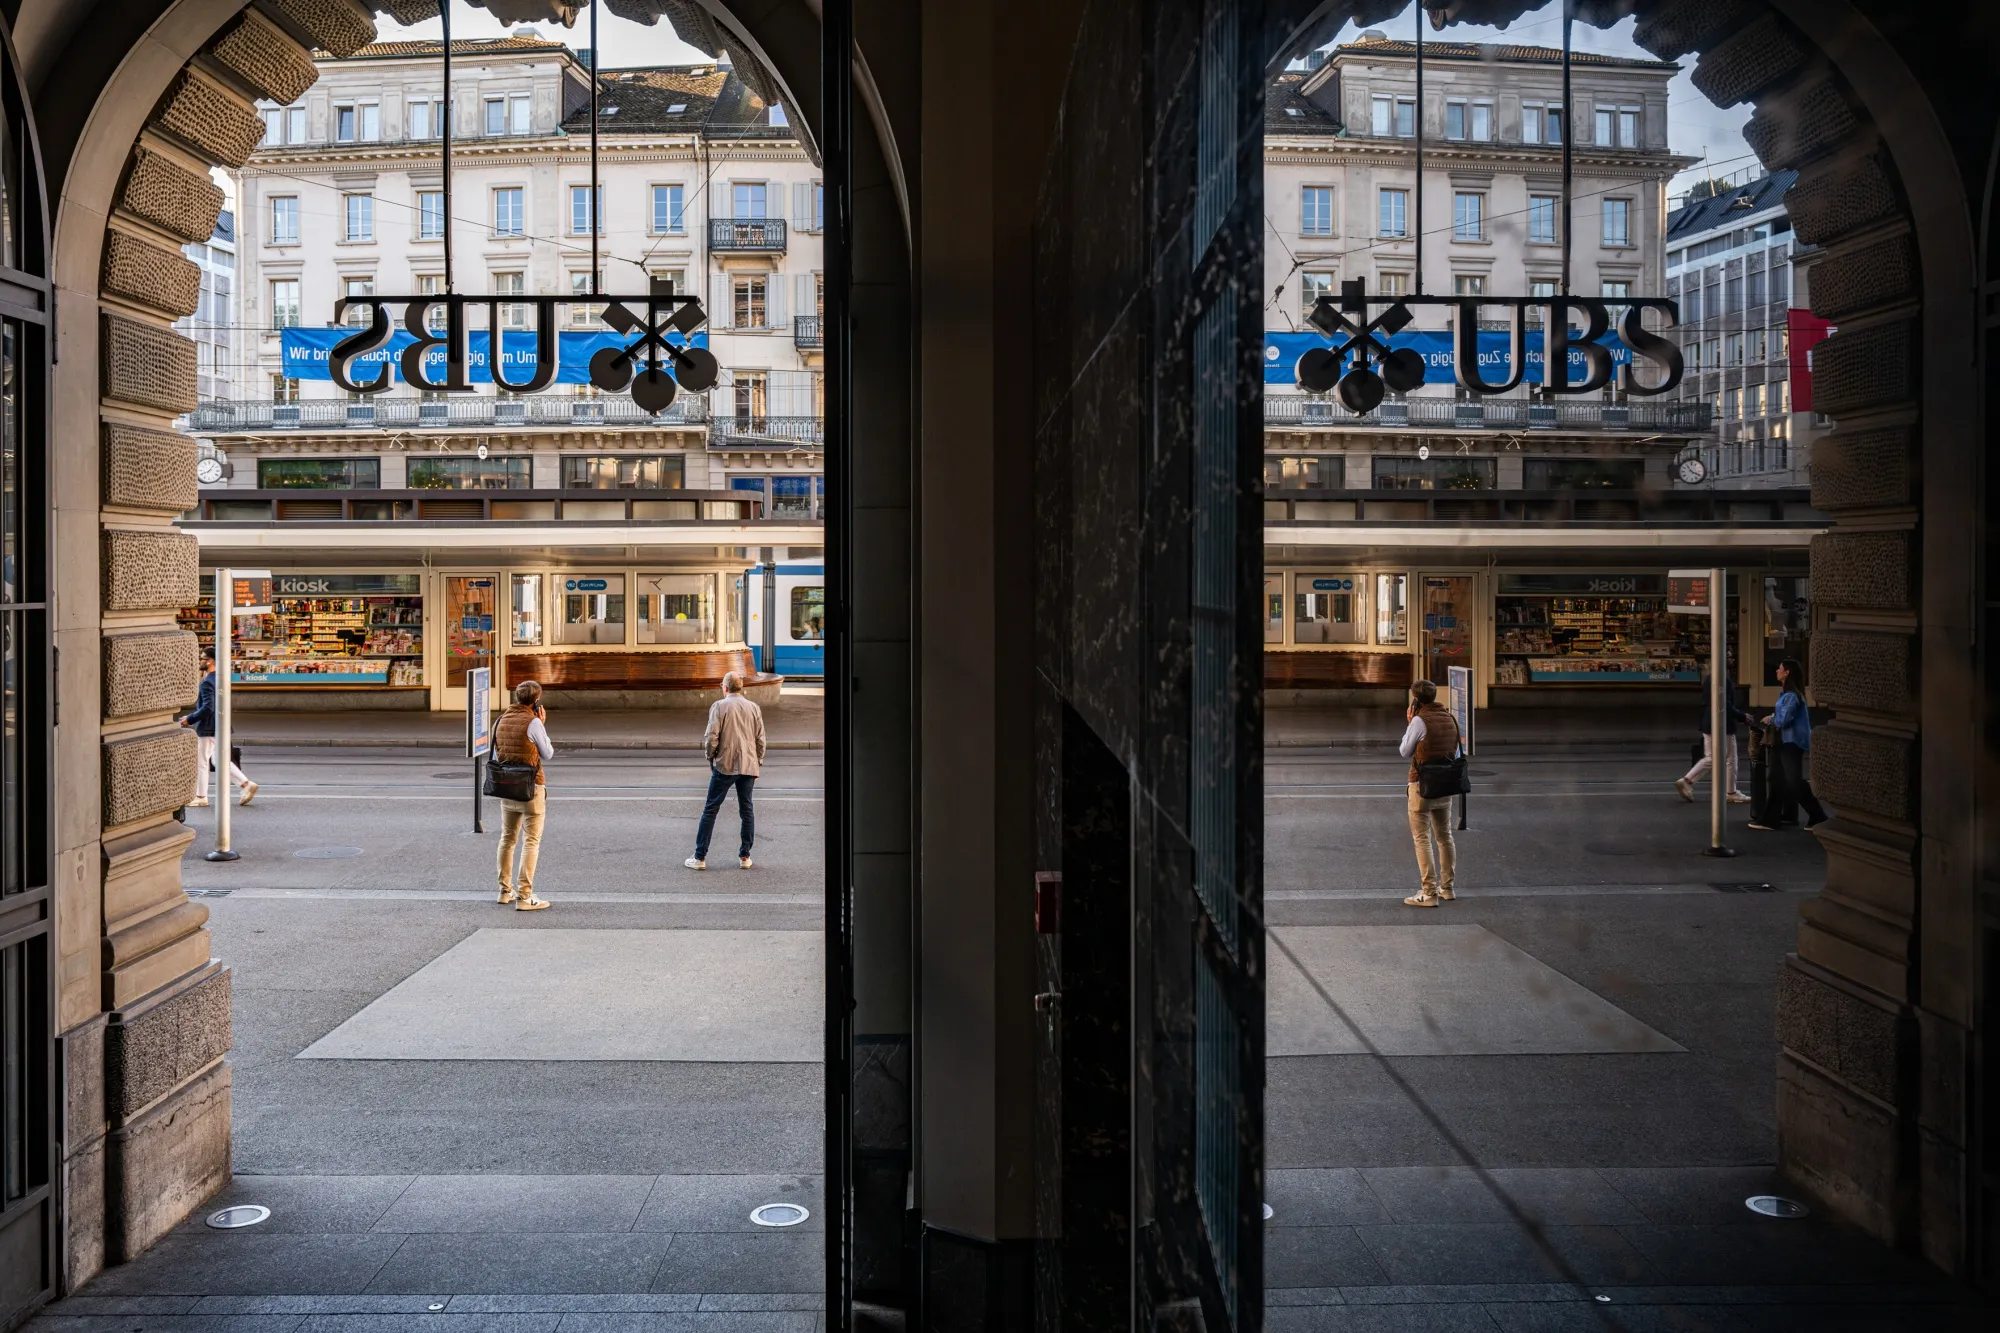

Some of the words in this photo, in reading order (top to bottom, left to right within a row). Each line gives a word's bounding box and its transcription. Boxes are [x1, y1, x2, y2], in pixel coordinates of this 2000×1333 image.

[289, 346, 310, 360] Wir
[1453, 296, 1684, 396] UBS
[281, 578, 329, 592] kiosk
